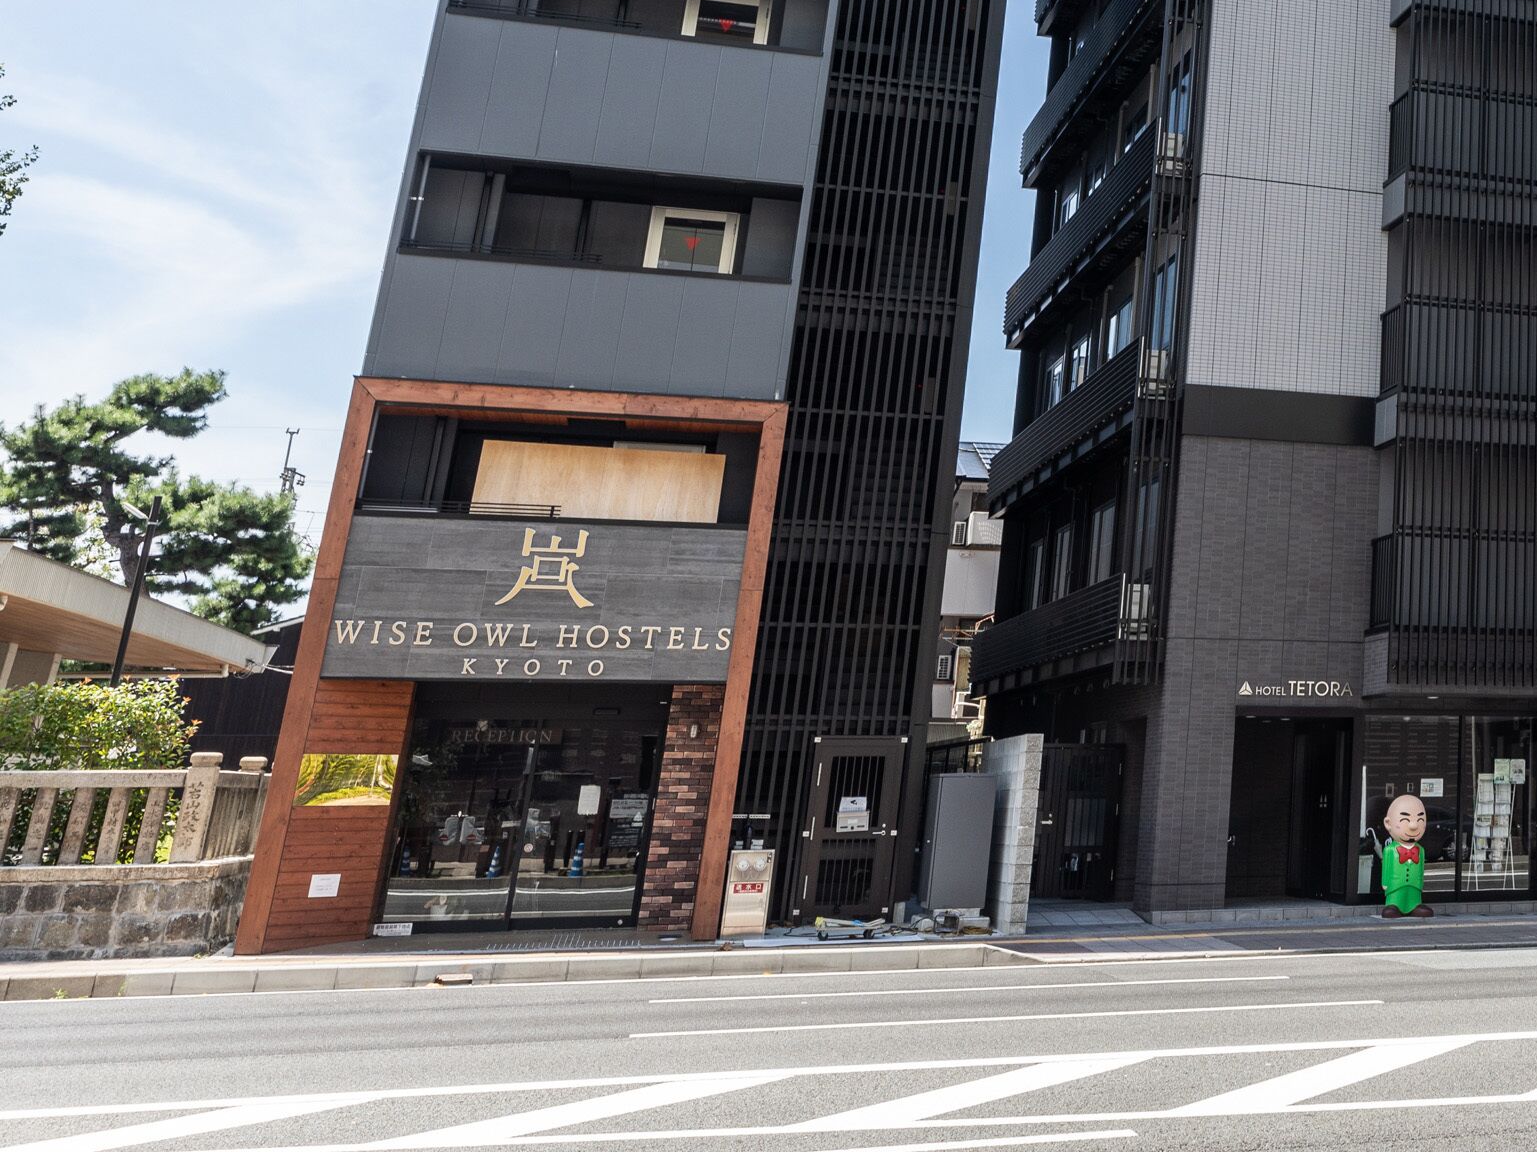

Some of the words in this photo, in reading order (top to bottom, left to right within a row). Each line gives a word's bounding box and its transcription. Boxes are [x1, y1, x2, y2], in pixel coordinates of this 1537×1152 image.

[335, 619, 434, 646] WISE
[453, 622, 538, 647] OWL
[556, 624, 732, 651] HOSTELS
[461, 658, 604, 676] KYOTO
[1255, 686, 1287, 696] HOTEL
[1288, 680, 1353, 697] TETORA
